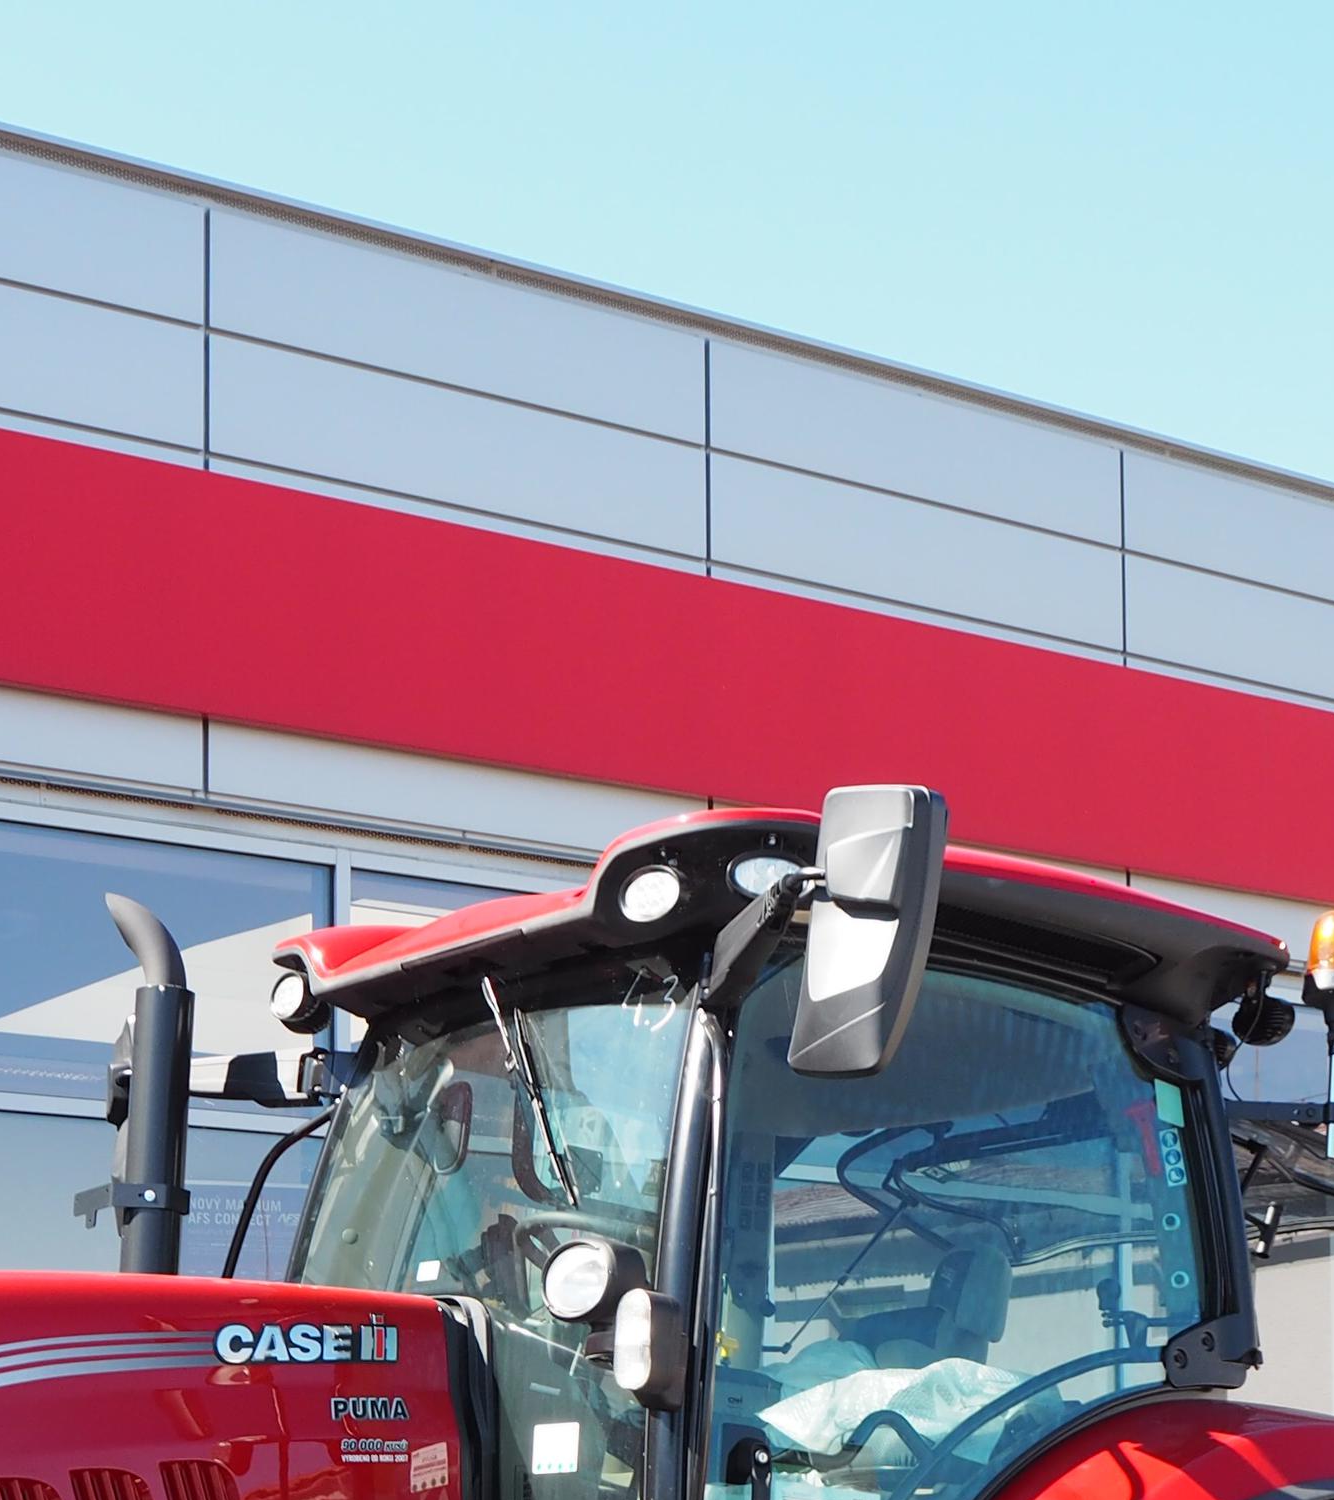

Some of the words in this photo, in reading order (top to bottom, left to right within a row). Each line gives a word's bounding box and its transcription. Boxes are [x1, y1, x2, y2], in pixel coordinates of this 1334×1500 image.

[225, 1198, 282, 1212] MANUM
[188, 1212, 211, 1225] AFS
[214, 1213, 272, 1226] CONECT
[213, 1322, 354, 1365] CASE
[330, 1396, 409, 1422] PUMA
[358, 1438, 383, 1452] 000
